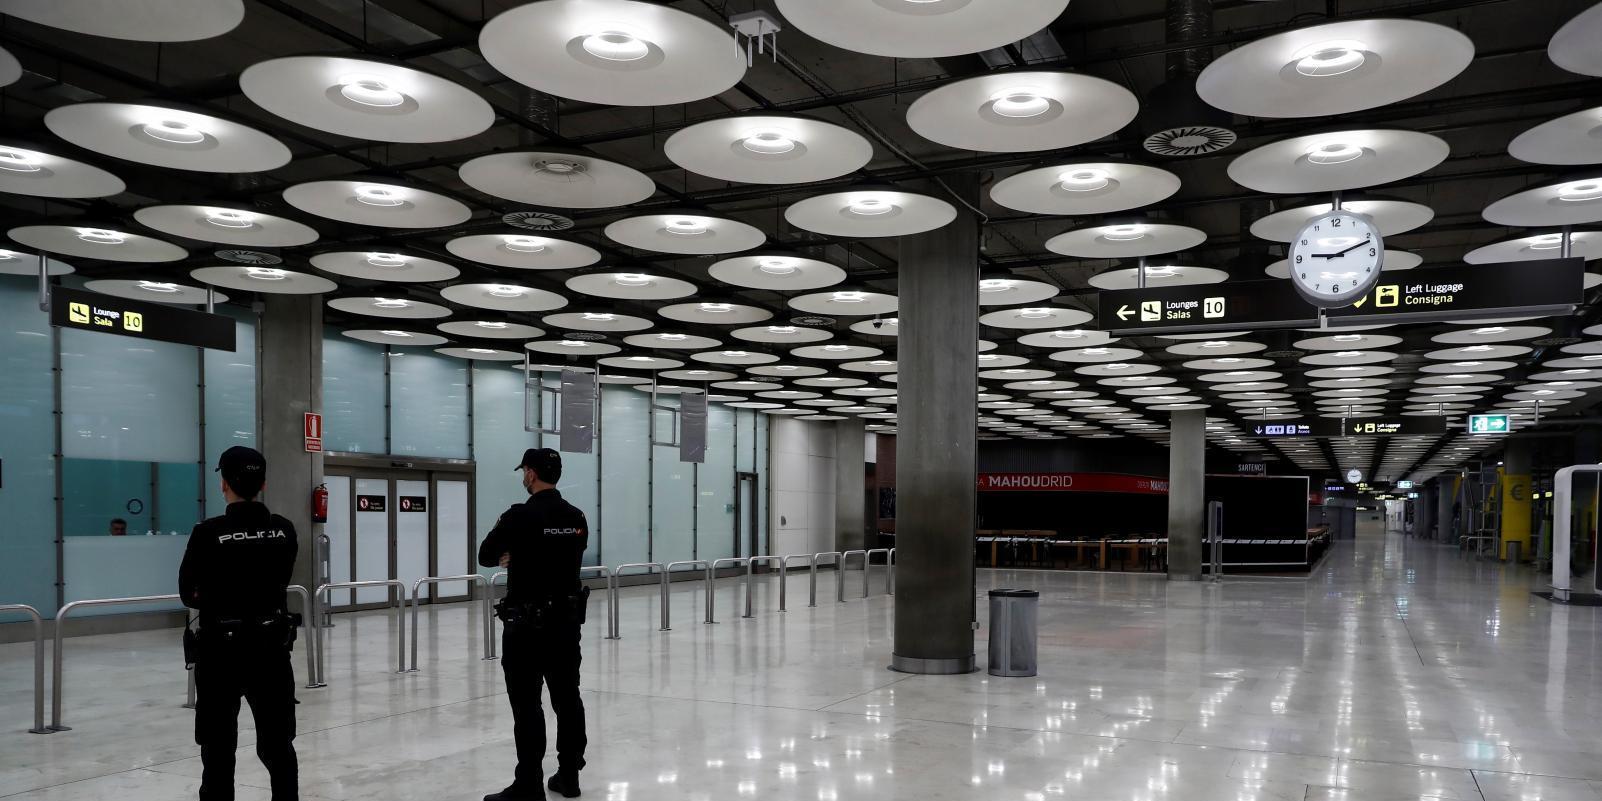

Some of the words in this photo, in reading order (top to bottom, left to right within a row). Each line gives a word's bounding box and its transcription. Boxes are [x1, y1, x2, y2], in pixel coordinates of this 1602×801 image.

[1331, 218, 1341, 228] 12
[1369, 248, 1376, 257] 3
[1296, 255, 1303, 264] 9
[1332, 284, 1339, 293] 6
[1405, 284, 1423, 294] Left
[1425, 283, 1464, 293] Luggage
[1405, 294, 1453, 305] Consigna
[1166, 300, 1198, 310] Lounges
[1206, 302, 1223, 314] 10
[93, 306, 120, 319] Lounge
[125, 315, 141, 328] 10
[1166, 310, 1191, 319] Salas
[94, 316, 113, 327] Sala
[989, 475, 1073, 487] MAHOUDRID
[218, 530, 286, 544] POLICIA
